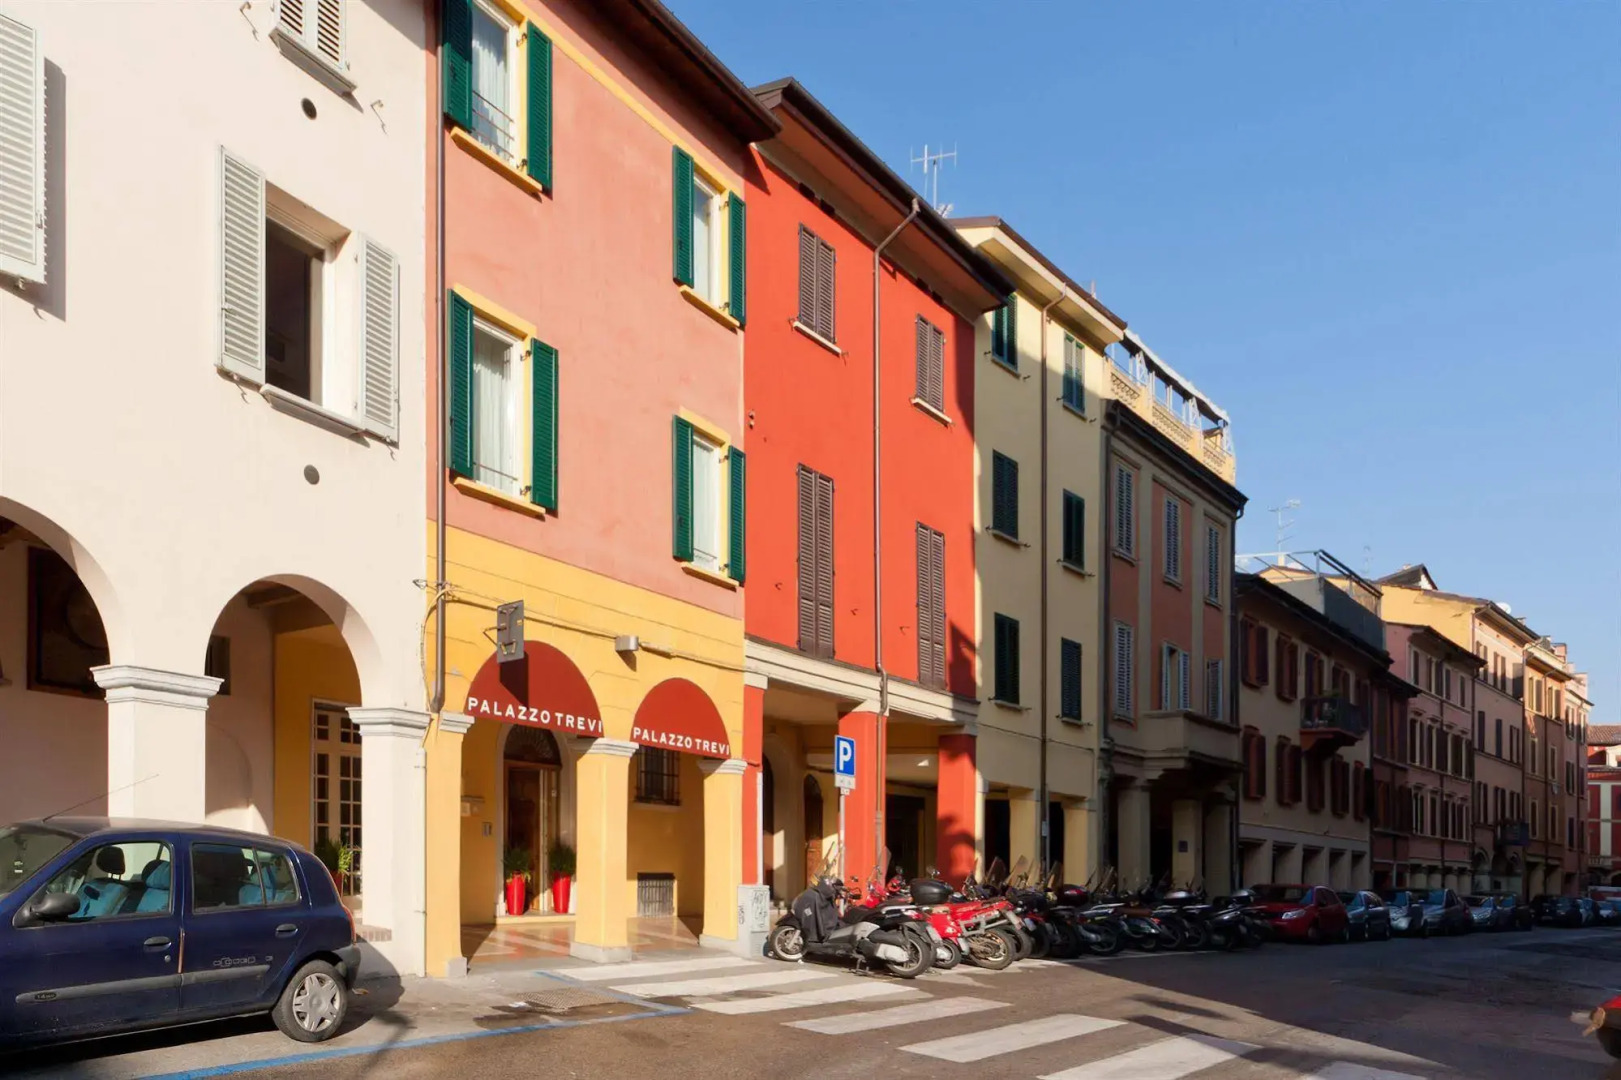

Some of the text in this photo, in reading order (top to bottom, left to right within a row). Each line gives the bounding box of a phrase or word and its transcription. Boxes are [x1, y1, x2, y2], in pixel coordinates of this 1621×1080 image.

[467, 697, 603, 733] PALAZZO TREVI
[632, 727, 730, 756] PALAZZO TREVI
[839, 740, 852, 771] P
